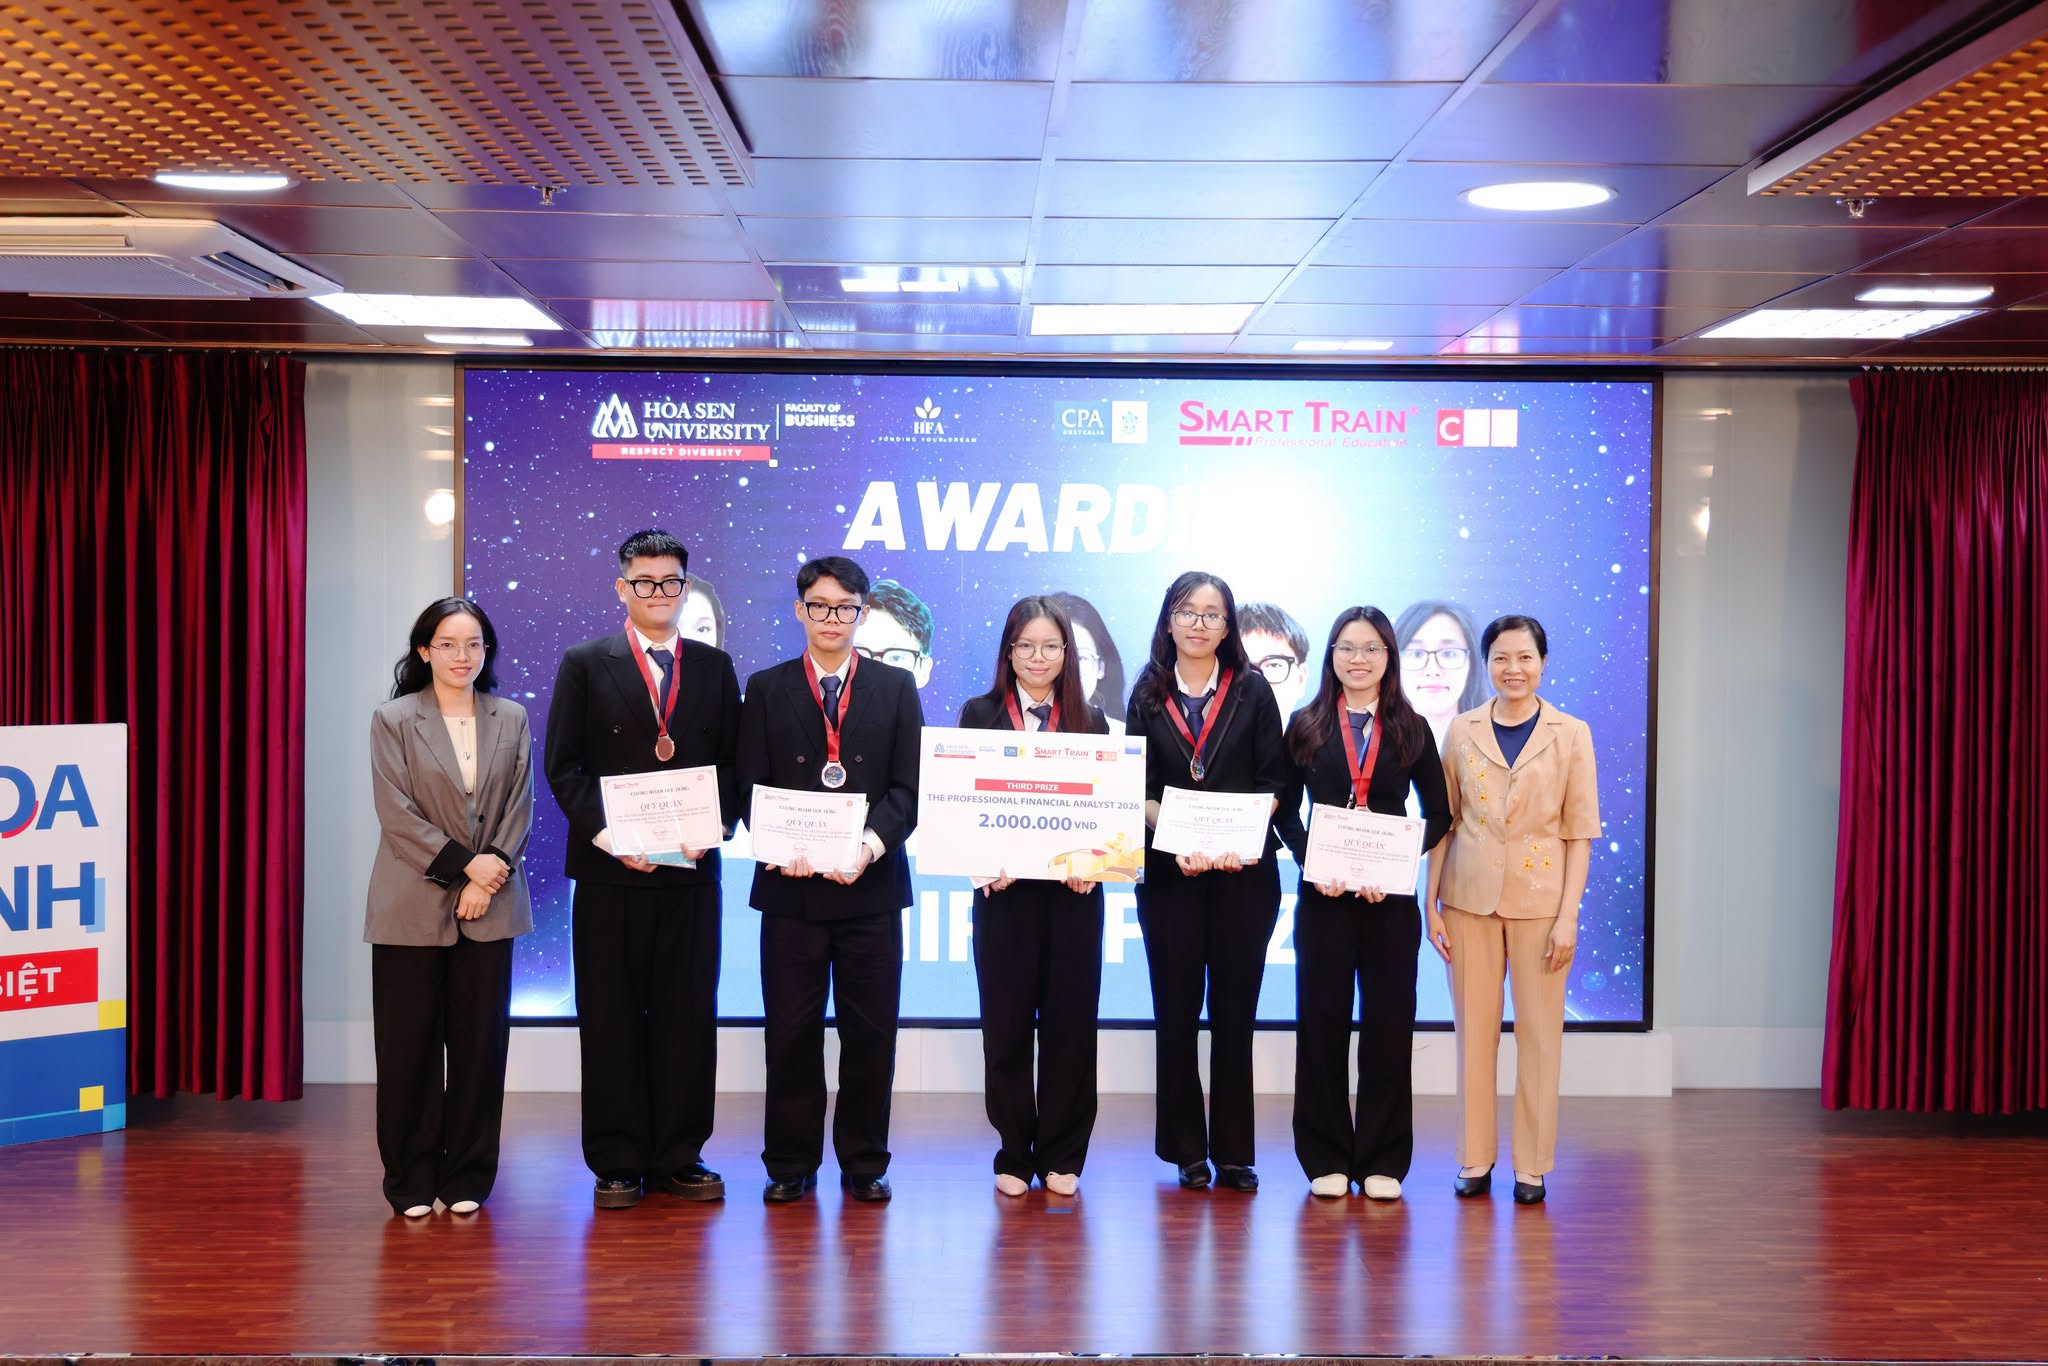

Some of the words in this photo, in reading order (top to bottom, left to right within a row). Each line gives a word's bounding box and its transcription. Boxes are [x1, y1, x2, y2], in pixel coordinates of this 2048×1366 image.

[695, 402, 736, 419] SEN
[785, 403, 826, 413] FACULTY
[827, 403, 841, 413] OF
[785, 414, 855, 427] BUSINESS
[1061, 408, 1104, 428] CPA
[1179, 400, 1294, 432] SMART
[1305, 401, 1407, 433] TRAIN
[643, 422, 770, 441] UNIVERSITY
[913, 421, 945, 434] HFA
[1254, 436, 1337, 448] Professional
[621, 447, 674, 457] RESPECT
[678, 448, 742, 457] DIVERSITY
[1034, 746, 1062, 756] SMART
[1064, 747, 1089, 757] TRAIN
[1006, 782, 1033, 790] THIRD
[1034, 783, 1059, 791] PRIZE
[927, 793, 945, 802] THE
[947, 794, 1018, 805] PROFESSIONAL
[1020, 797, 1071, 807] FINANCIAL
[1073, 799, 1115, 809] ANALYST
[1117, 802, 1140, 810] 2026
[978, 813, 1072, 831] 2.000.000
[1074, 821, 1098, 830] VND
[0, 961, 62, 1002] IỆT
